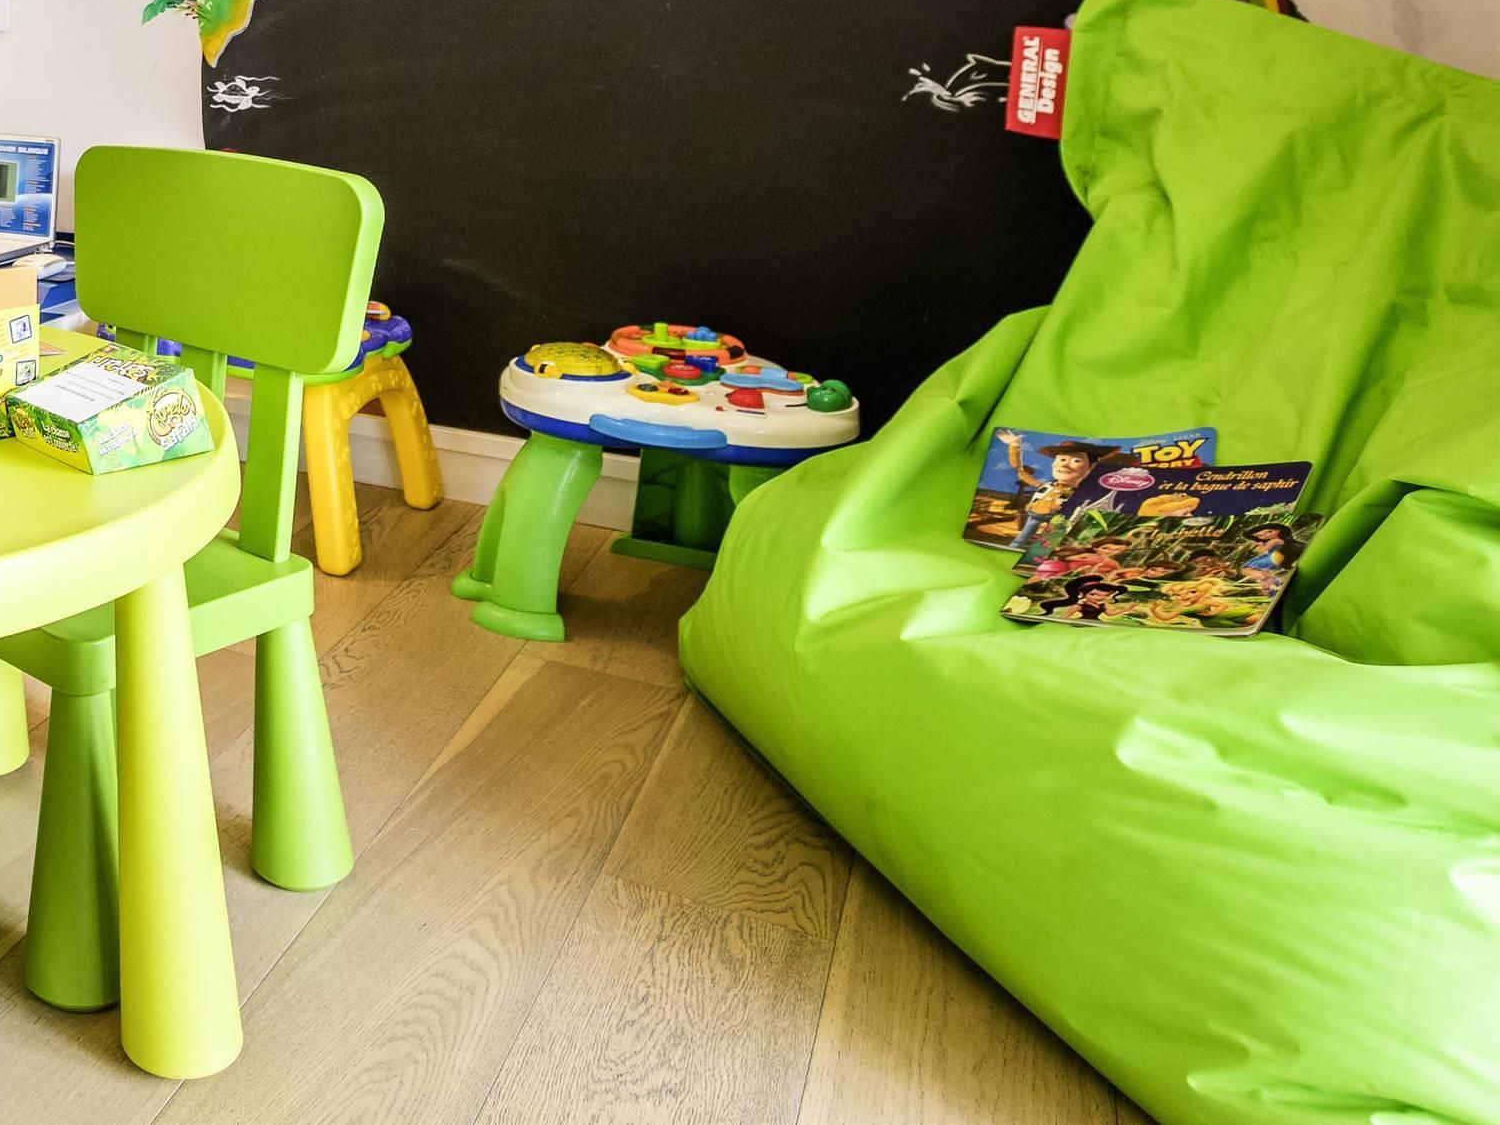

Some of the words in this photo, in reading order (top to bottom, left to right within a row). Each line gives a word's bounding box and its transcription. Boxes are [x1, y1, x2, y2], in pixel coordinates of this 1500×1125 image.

[1037, 48, 1064, 115] Design
[1132, 437, 1210, 465] TOY
[1189, 482, 1233, 493] bague
[1235, 481, 1251, 490] de
[1253, 478, 1300, 492] saphir
[1195, 470, 1269, 482] Cendrillon
